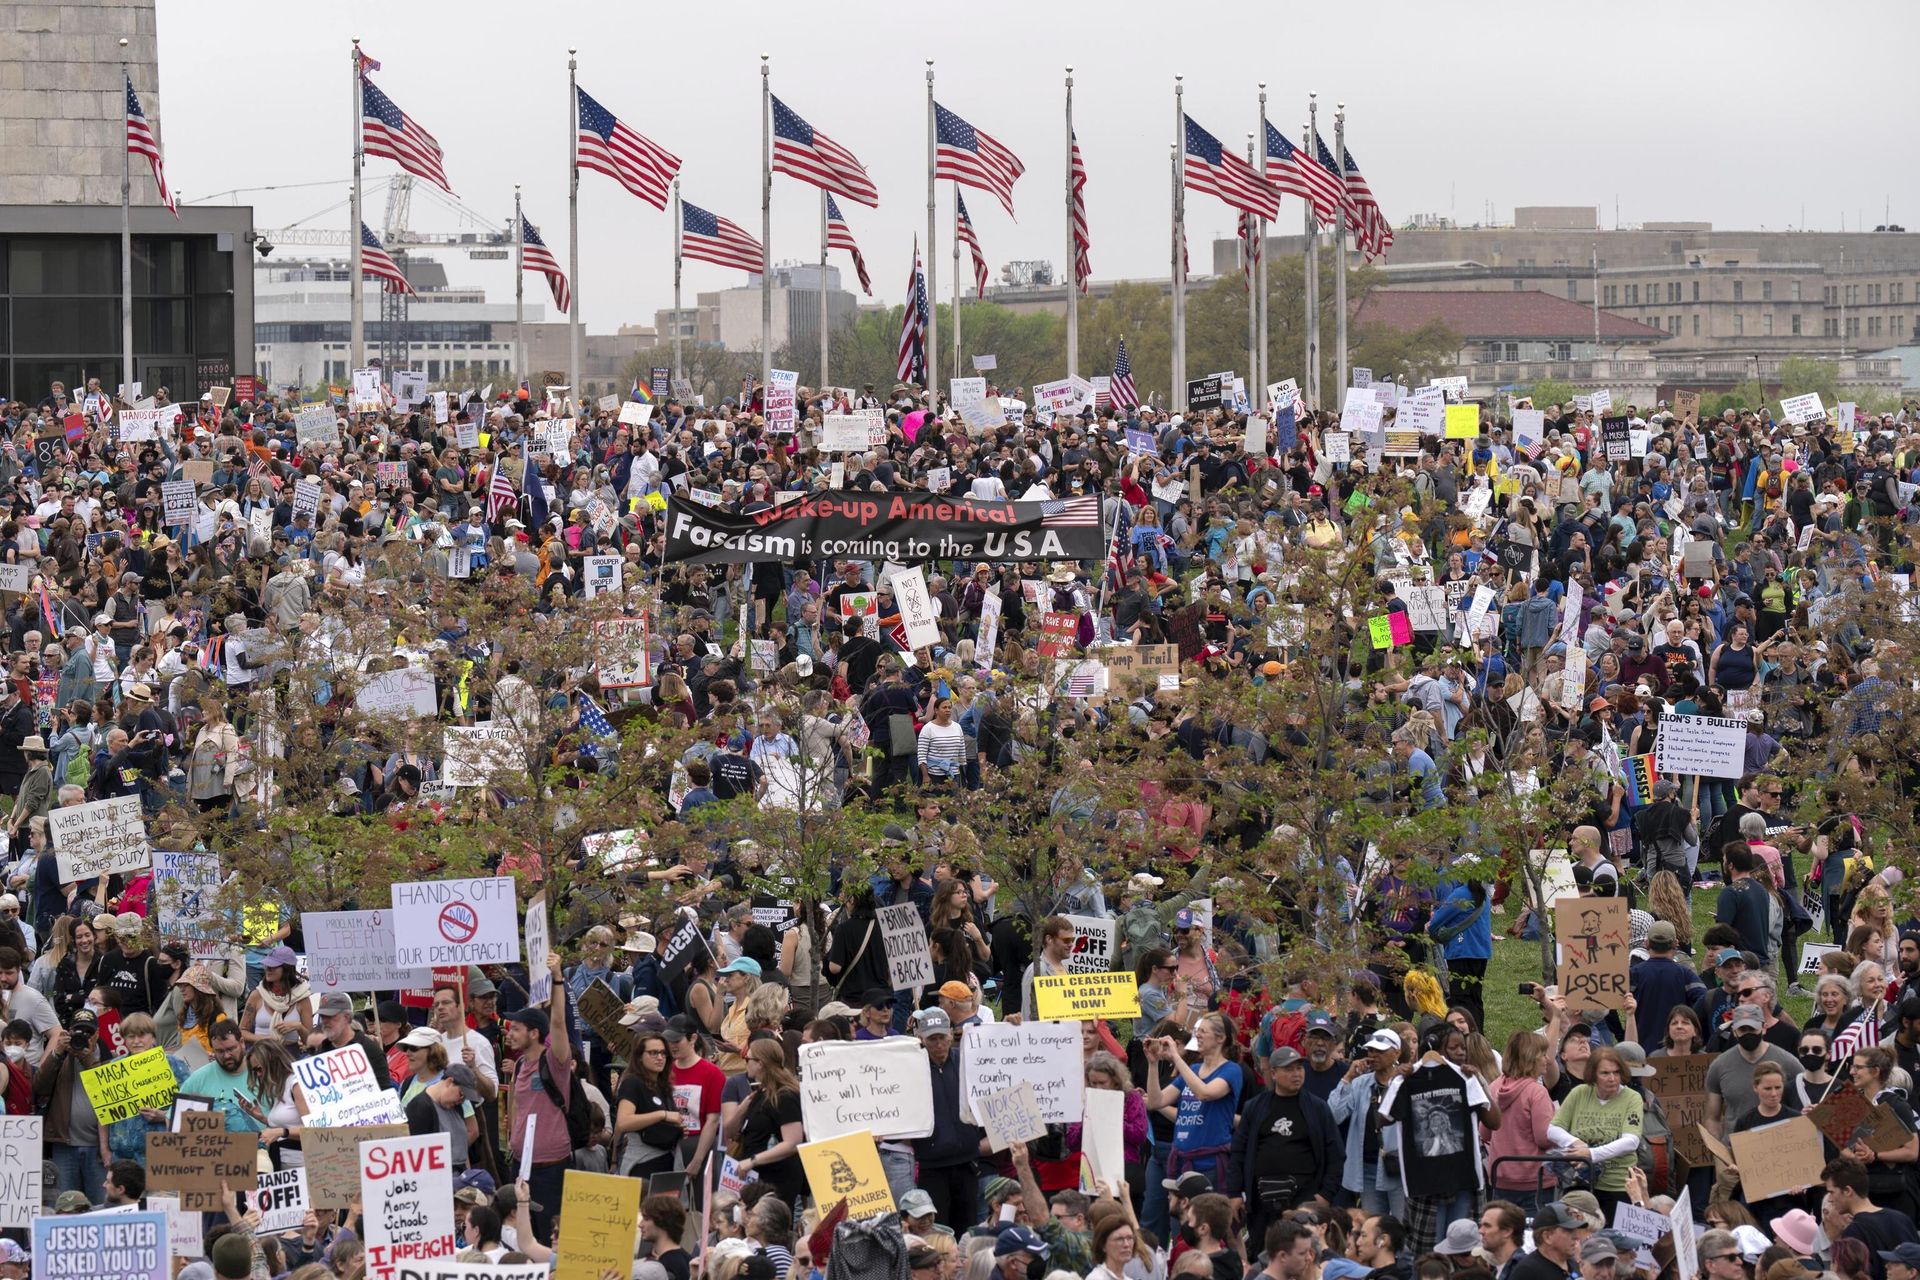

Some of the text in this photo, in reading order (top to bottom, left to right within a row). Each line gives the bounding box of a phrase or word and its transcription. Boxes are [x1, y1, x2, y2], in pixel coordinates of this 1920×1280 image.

[1278, 383, 1289, 393] NO
[1052, 399, 1063, 410] FIRE
[121, 410, 148, 422] HANDS
[1804, 412, 1823, 421] STUFF
[526, 445, 547, 453] OFF!
[167, 493, 193, 502] HANDS
[168, 500, 194, 511] OFF!
[752, 496, 1017, 528] Wake-up America!
[672, 513, 1070, 559] Fascism is coming to the U.S.A.
[592, 558, 620, 566] GROUPER
[590, 578, 614, 586] GROPER
[902, 576, 918, 588] NOT
[909, 618, 932, 630] PRESIDENT
[913, 612, 922, 621] MY
[1045, 615, 1075, 629] SAVE OUR
[1659, 713, 1747, 728] ELON'S 5 BULLETS
[1660, 724, 1664, 732] 1
[1658, 734, 1665, 742] 2
[1657, 743, 1665, 752] 3
[1657, 753, 1664, 761] 4
[1657, 763, 1664, 771] 5
[1632, 758, 1651, 799] RESIST
[422, 780, 444, 794] Stand
[54, 813, 85, 830] WHEN
[1766, 825, 1789, 836] RESIST
[71, 847, 147, 876] BECOMES DUTY
[399, 878, 510, 906] HANDS OFF
[326, 917, 363, 930] PROCLAIM
[883, 905, 914, 930] BRING
[315, 930, 395, 950] LIBERTY
[1075, 926, 1107, 938] HANDS
[883, 930, 929, 958] DEMOCRACY
[1073, 936, 1108, 955] OFF
[308, 953, 357, 970] Throughout
[399, 941, 510, 966] OUR DEMOCRACY!
[1073, 955, 1110, 968] CANCER
[896, 957, 926, 982] BACK
[1039, 973, 1133, 988] FULL CEASEFIRE
[1565, 973, 1628, 997] LOSER
[1063, 987, 1111, 998] IN GAZA
[1072, 1000, 1107, 1010] NOW!
[927, 1018, 942, 1026] DC
[967, 1031, 1075, 1050] It is evil to conquer
[807, 1047, 826, 1059] Evil
[974, 1054, 1047, 1067] some one elses
[94, 1061, 130, 1086] MAGA
[297, 1048, 369, 1090] USAID
[808, 1063, 887, 1082] Trump says
[101, 1069, 172, 1104] MUSK (MUSKRATS)
[978, 1071, 1012, 1087] country
[309, 1084, 344, 1105] is both
[808, 1081, 901, 1104] We will have
[970, 1078, 1067, 1099] And as part
[1423, 1090, 1432, 1099] MY
[1433, 1087, 1461, 1097] PRESIDENT
[984, 1087, 1027, 1120] WORST
[1180, 1100, 1202, 1111] OVER
[109, 1103, 127, 1122] NO
[835, 1105, 901, 1124] Greenland
[990, 1107, 1036, 1134] SEQUEL
[187, 1115, 219, 1131] YOU
[195, 1135, 232, 1146] SPELL
[314, 1131, 345, 1146] Why
[1002, 1124, 1041, 1143] EVER
[176, 1146, 226, 1158] "FELON"
[151, 1160, 253, 1177] WITHOUT "ELON"
[365, 1145, 445, 1180] SAVE
[256, 1169, 299, 1189] HANDS
[322, 1188, 337, 1199] Do
[384, 1180, 418, 1198] Jobs
[185, 1193, 216, 1208] FDT
[257, 1184, 302, 1213] OFF!
[565, 1187, 620, 1212] Fascism
[383, 1199, 420, 1216] Money
[384, 1214, 429, 1230] Schools
[45, 1220, 158, 1251] JESUS NEVER
[390, 1230, 423, 1244] Lives
[368, 1238, 456, 1268] IMPEACH
[562, 1251, 619, 1267] Genocide
[44, 1247, 157, 1277] ASKED YOU TO
